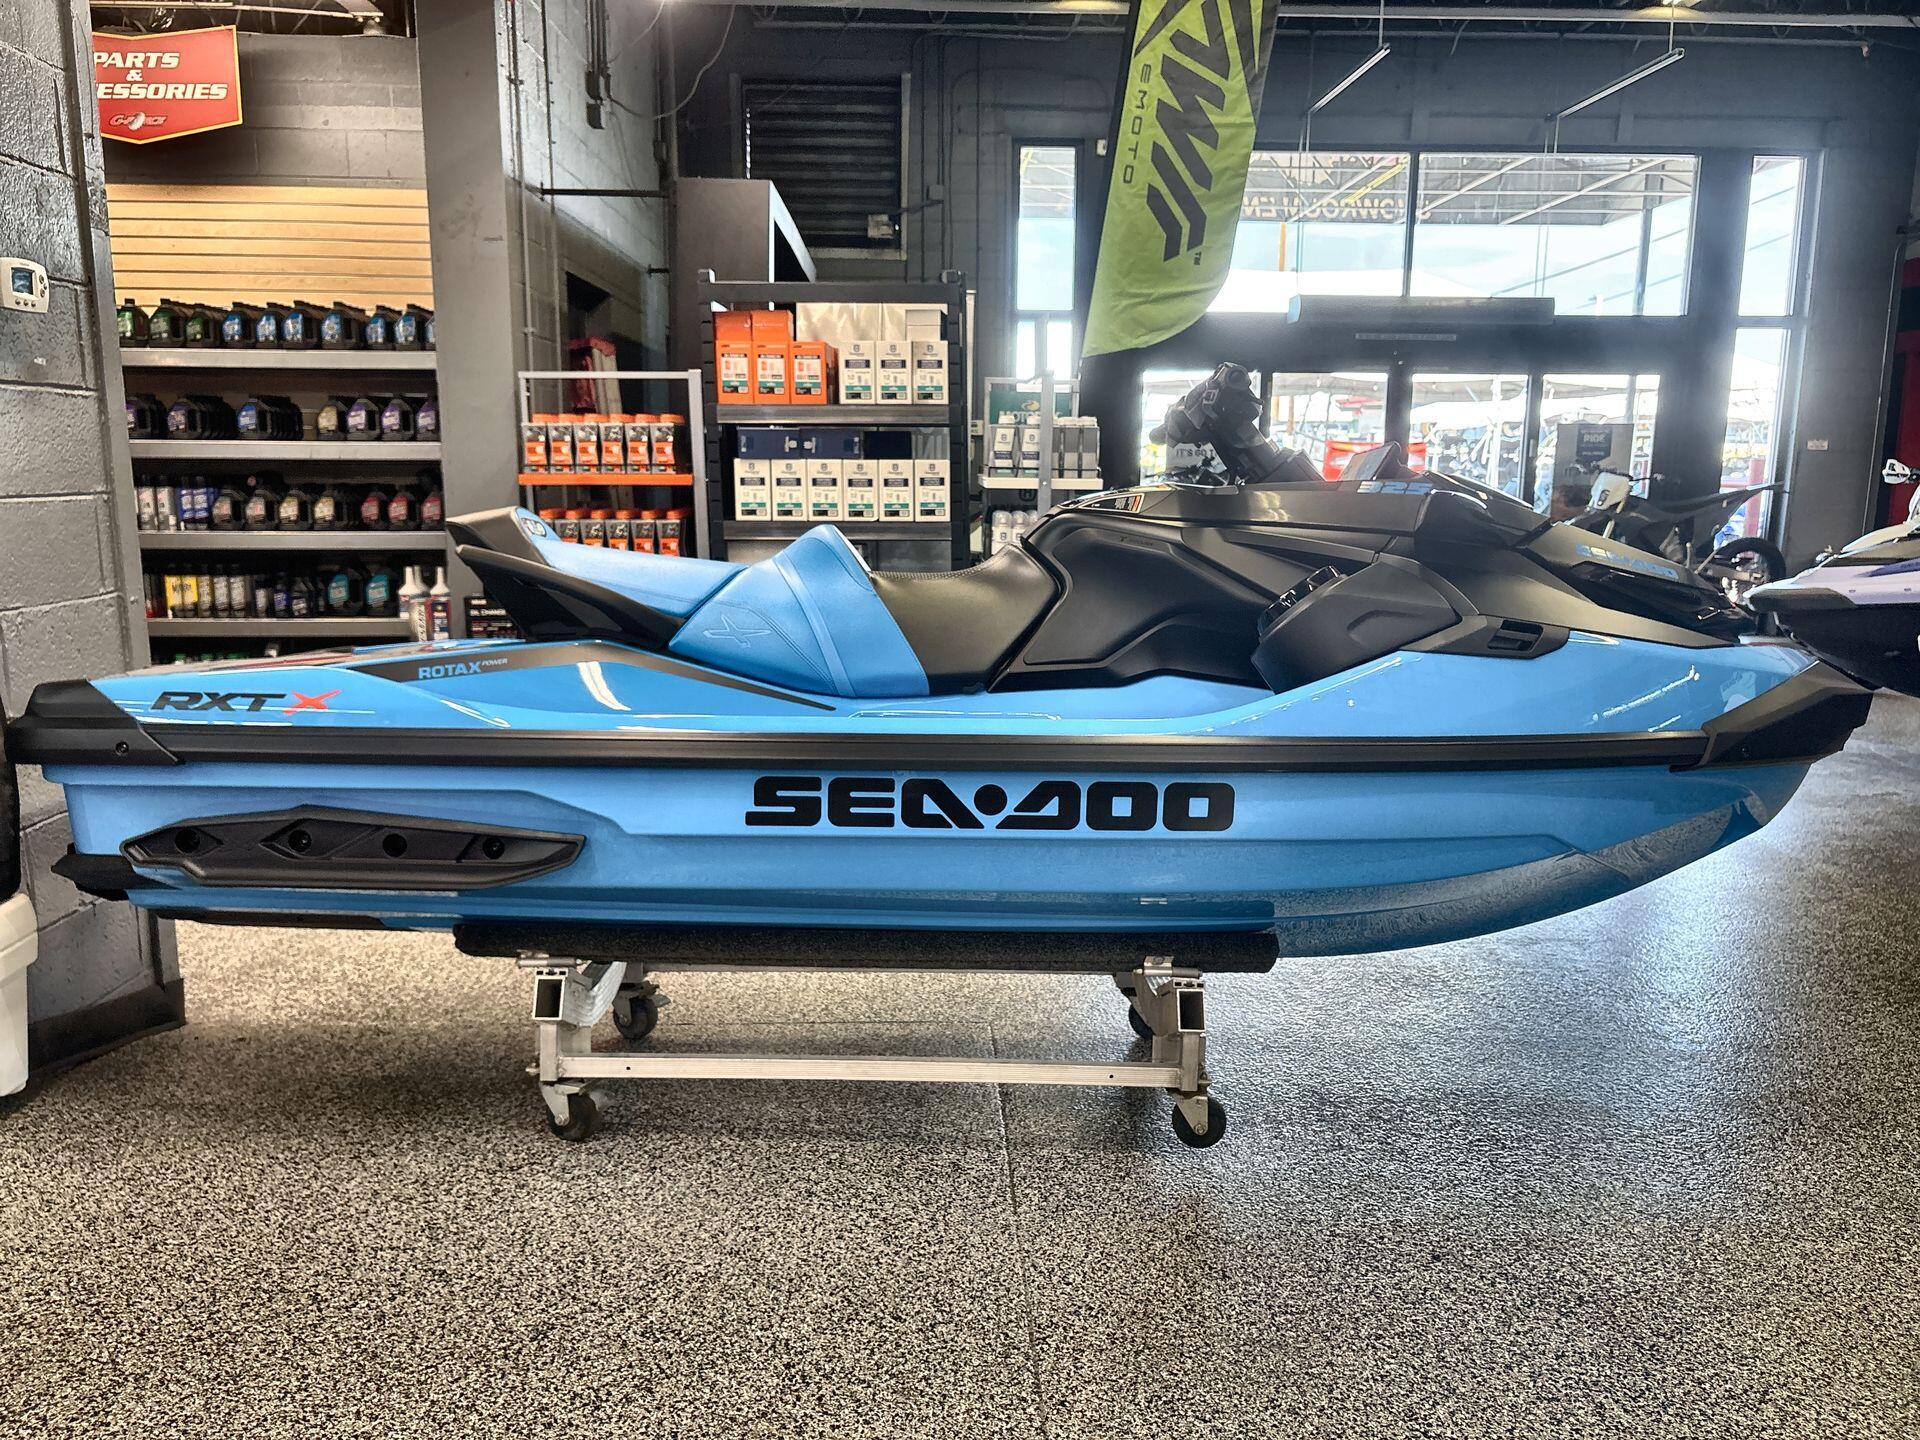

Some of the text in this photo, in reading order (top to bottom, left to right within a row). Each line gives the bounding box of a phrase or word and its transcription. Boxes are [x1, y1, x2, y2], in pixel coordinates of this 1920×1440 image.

[94, 51, 180, 68] PARTS
[126, 69, 143, 82] &
[95, 83, 229, 100] ESSORIES
[1356, 480, 1433, 496] 325
[418, 657, 508, 679] ROTAX POWER
[151, 691, 287, 712] RXT
